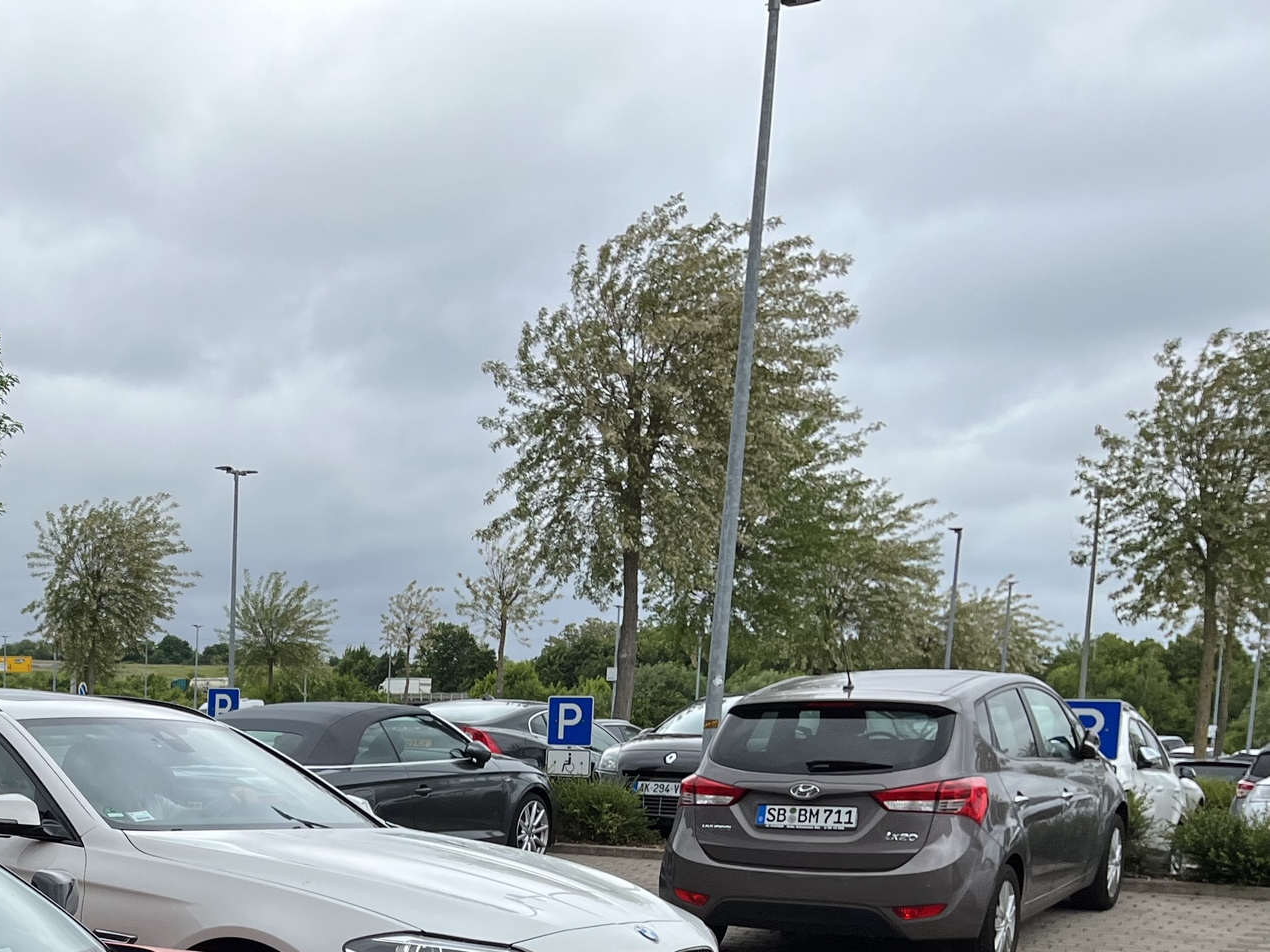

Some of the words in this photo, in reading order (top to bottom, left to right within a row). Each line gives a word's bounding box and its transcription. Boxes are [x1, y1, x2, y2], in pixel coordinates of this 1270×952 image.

[215, 693, 232, 718] P
[558, 703, 583, 740] P
[766, 807, 787, 823] SB
[798, 808, 820, 824] BM
[823, 809, 854, 825] 711
